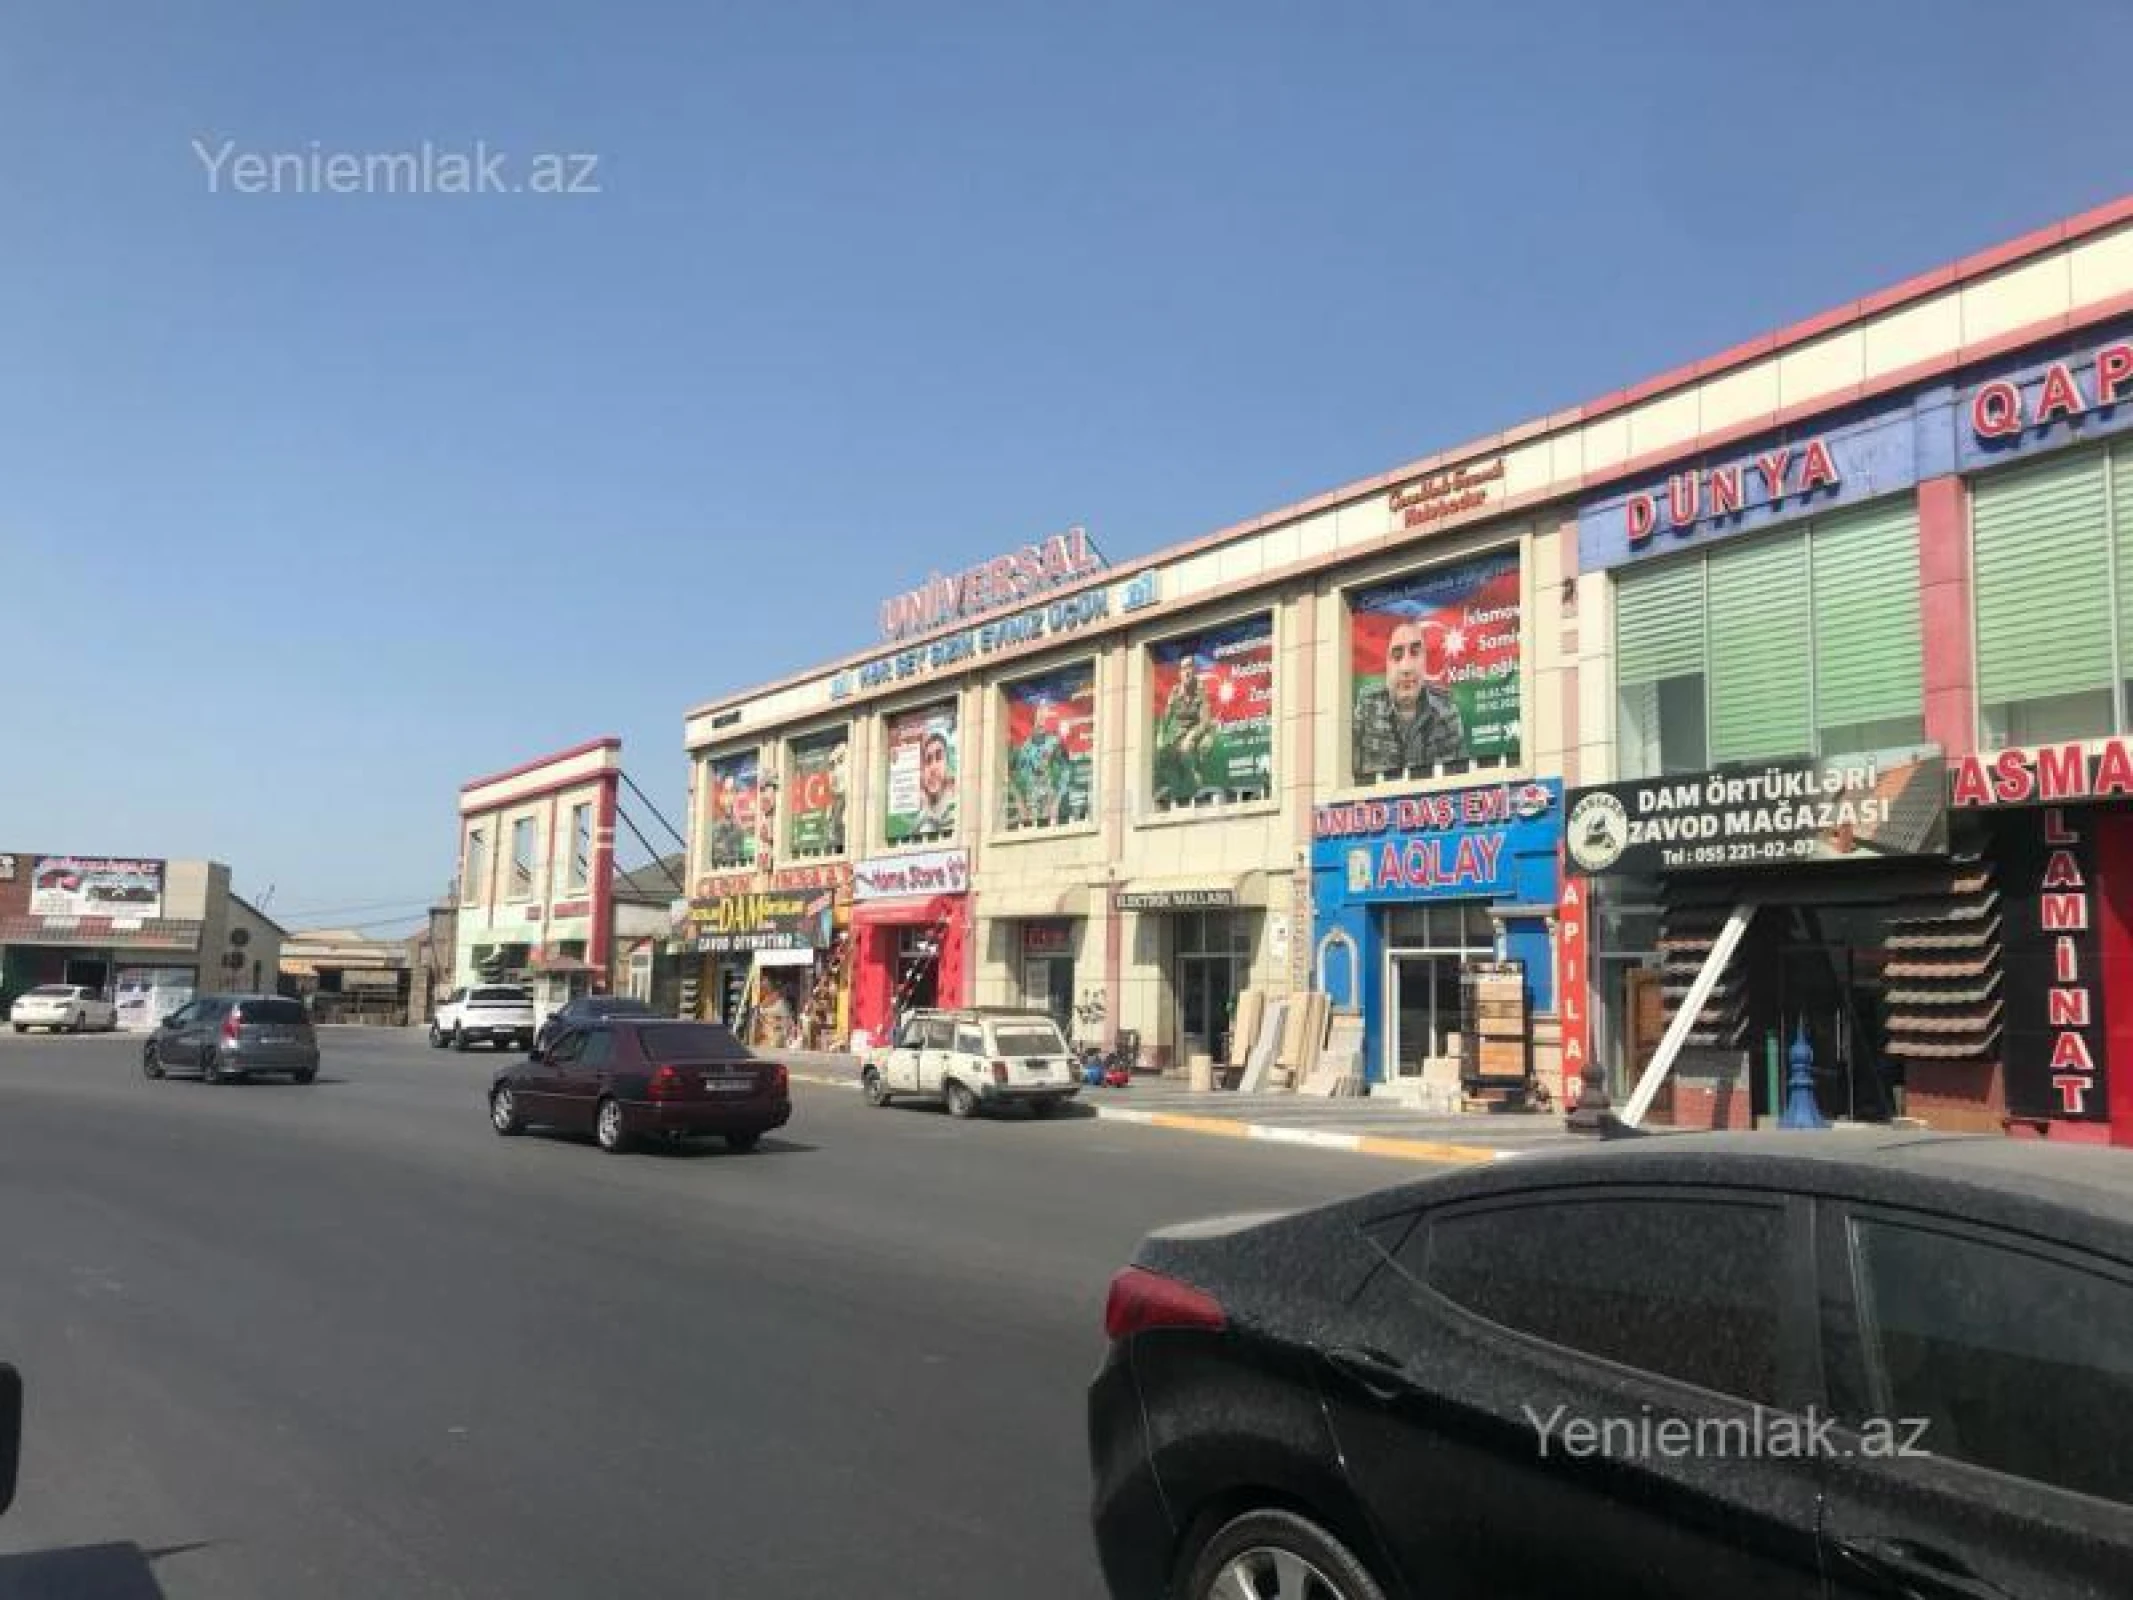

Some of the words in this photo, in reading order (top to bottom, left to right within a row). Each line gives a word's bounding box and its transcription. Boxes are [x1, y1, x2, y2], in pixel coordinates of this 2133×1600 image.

[1972, 344, 2133, 438] QAP
[1639, 784, 1699, 812] DAM
[1953, 740, 2133, 806] ASMA
[1629, 816, 1718, 845] ZAVOD
[1724, 800, 1889, 835] MAĞAZASI
[1377, 834, 1504, 889] AQLAY
